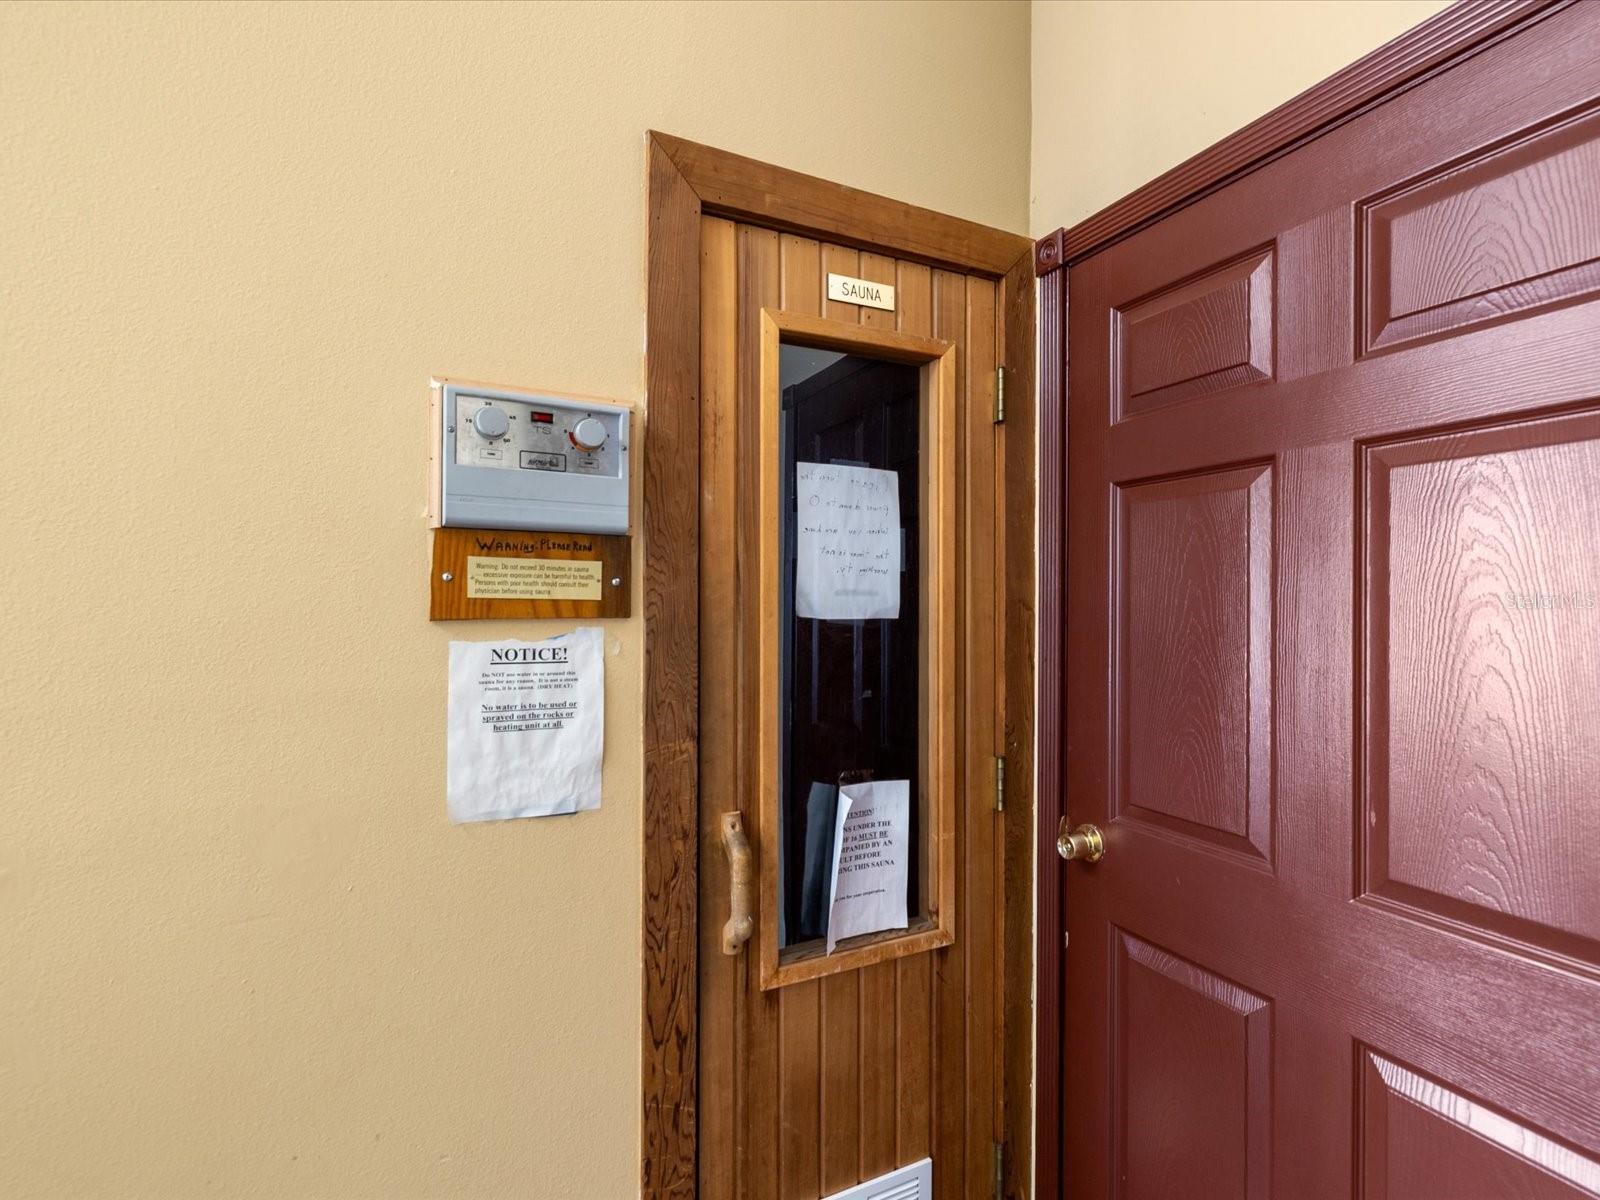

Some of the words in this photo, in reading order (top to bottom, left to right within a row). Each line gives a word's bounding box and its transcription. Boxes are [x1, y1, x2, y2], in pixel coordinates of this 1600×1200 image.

[842, 282, 882, 302] SAUNA
[490, 648, 568, 664] NOTICE!
[482, 704, 494, 712] No
[496, 704, 518, 712] water
[520, 702, 528, 711] is
[528, 702, 537, 710] to
[538, 701, 548, 710] be
[549, 701, 567, 709] used
[482, 714, 515, 723] sprayed
[528, 712, 541, 720] the
[542, 711, 564, 719] rocks
[493, 724, 523, 732] heating
[524, 722, 541, 730] unit
[853, 822, 876, 830] UNDER
[858, 832, 878, 841] MUST
[880, 830, 888, 838] BE
[872, 840, 880, 848] BY
[882, 839, 893, 847] AN
[854, 851, 881, 860] BEFORE
[854, 862, 870, 871] THIS
[871, 859, 895, 868] SAUNA
